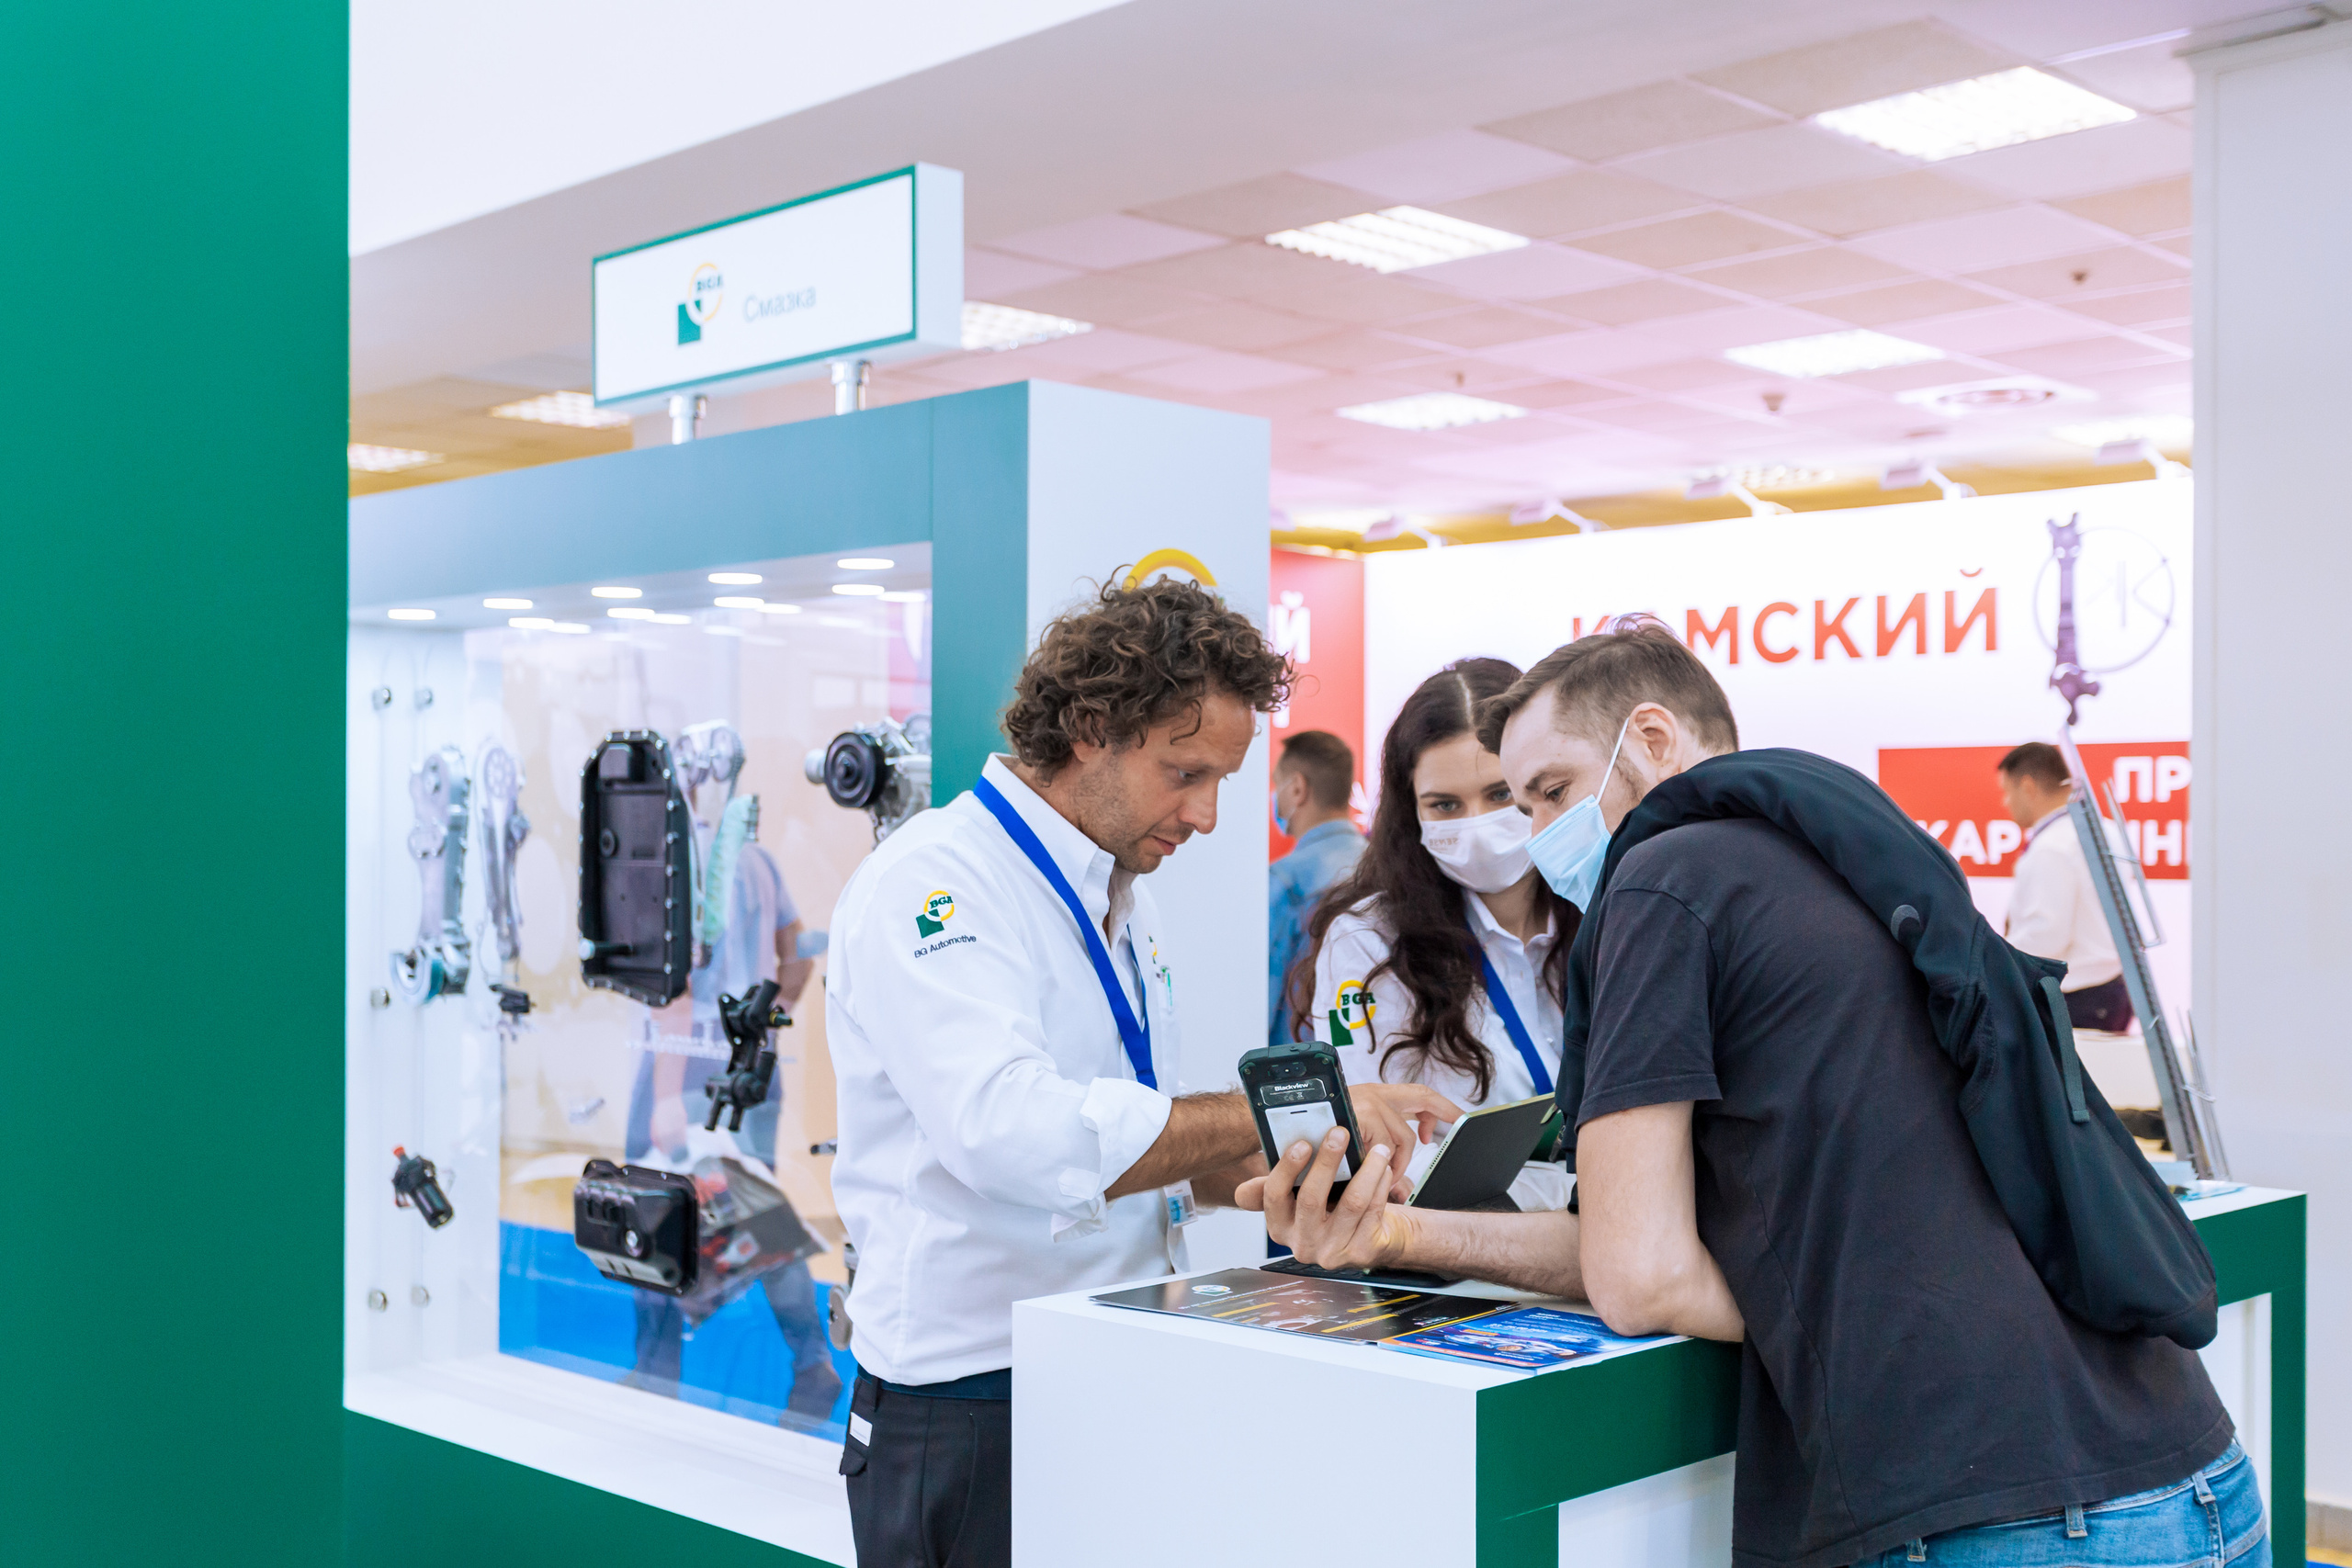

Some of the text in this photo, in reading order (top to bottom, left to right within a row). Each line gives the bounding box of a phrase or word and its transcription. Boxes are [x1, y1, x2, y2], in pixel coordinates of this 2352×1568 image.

[743, 287, 816, 322] Смазка
[1573, 568, 1997, 664] МСКИЙ
[930, 896, 954, 908] BGA
[930, 935, 977, 953] Automotive
[1274, 1083, 1309, 1091] Blackview
